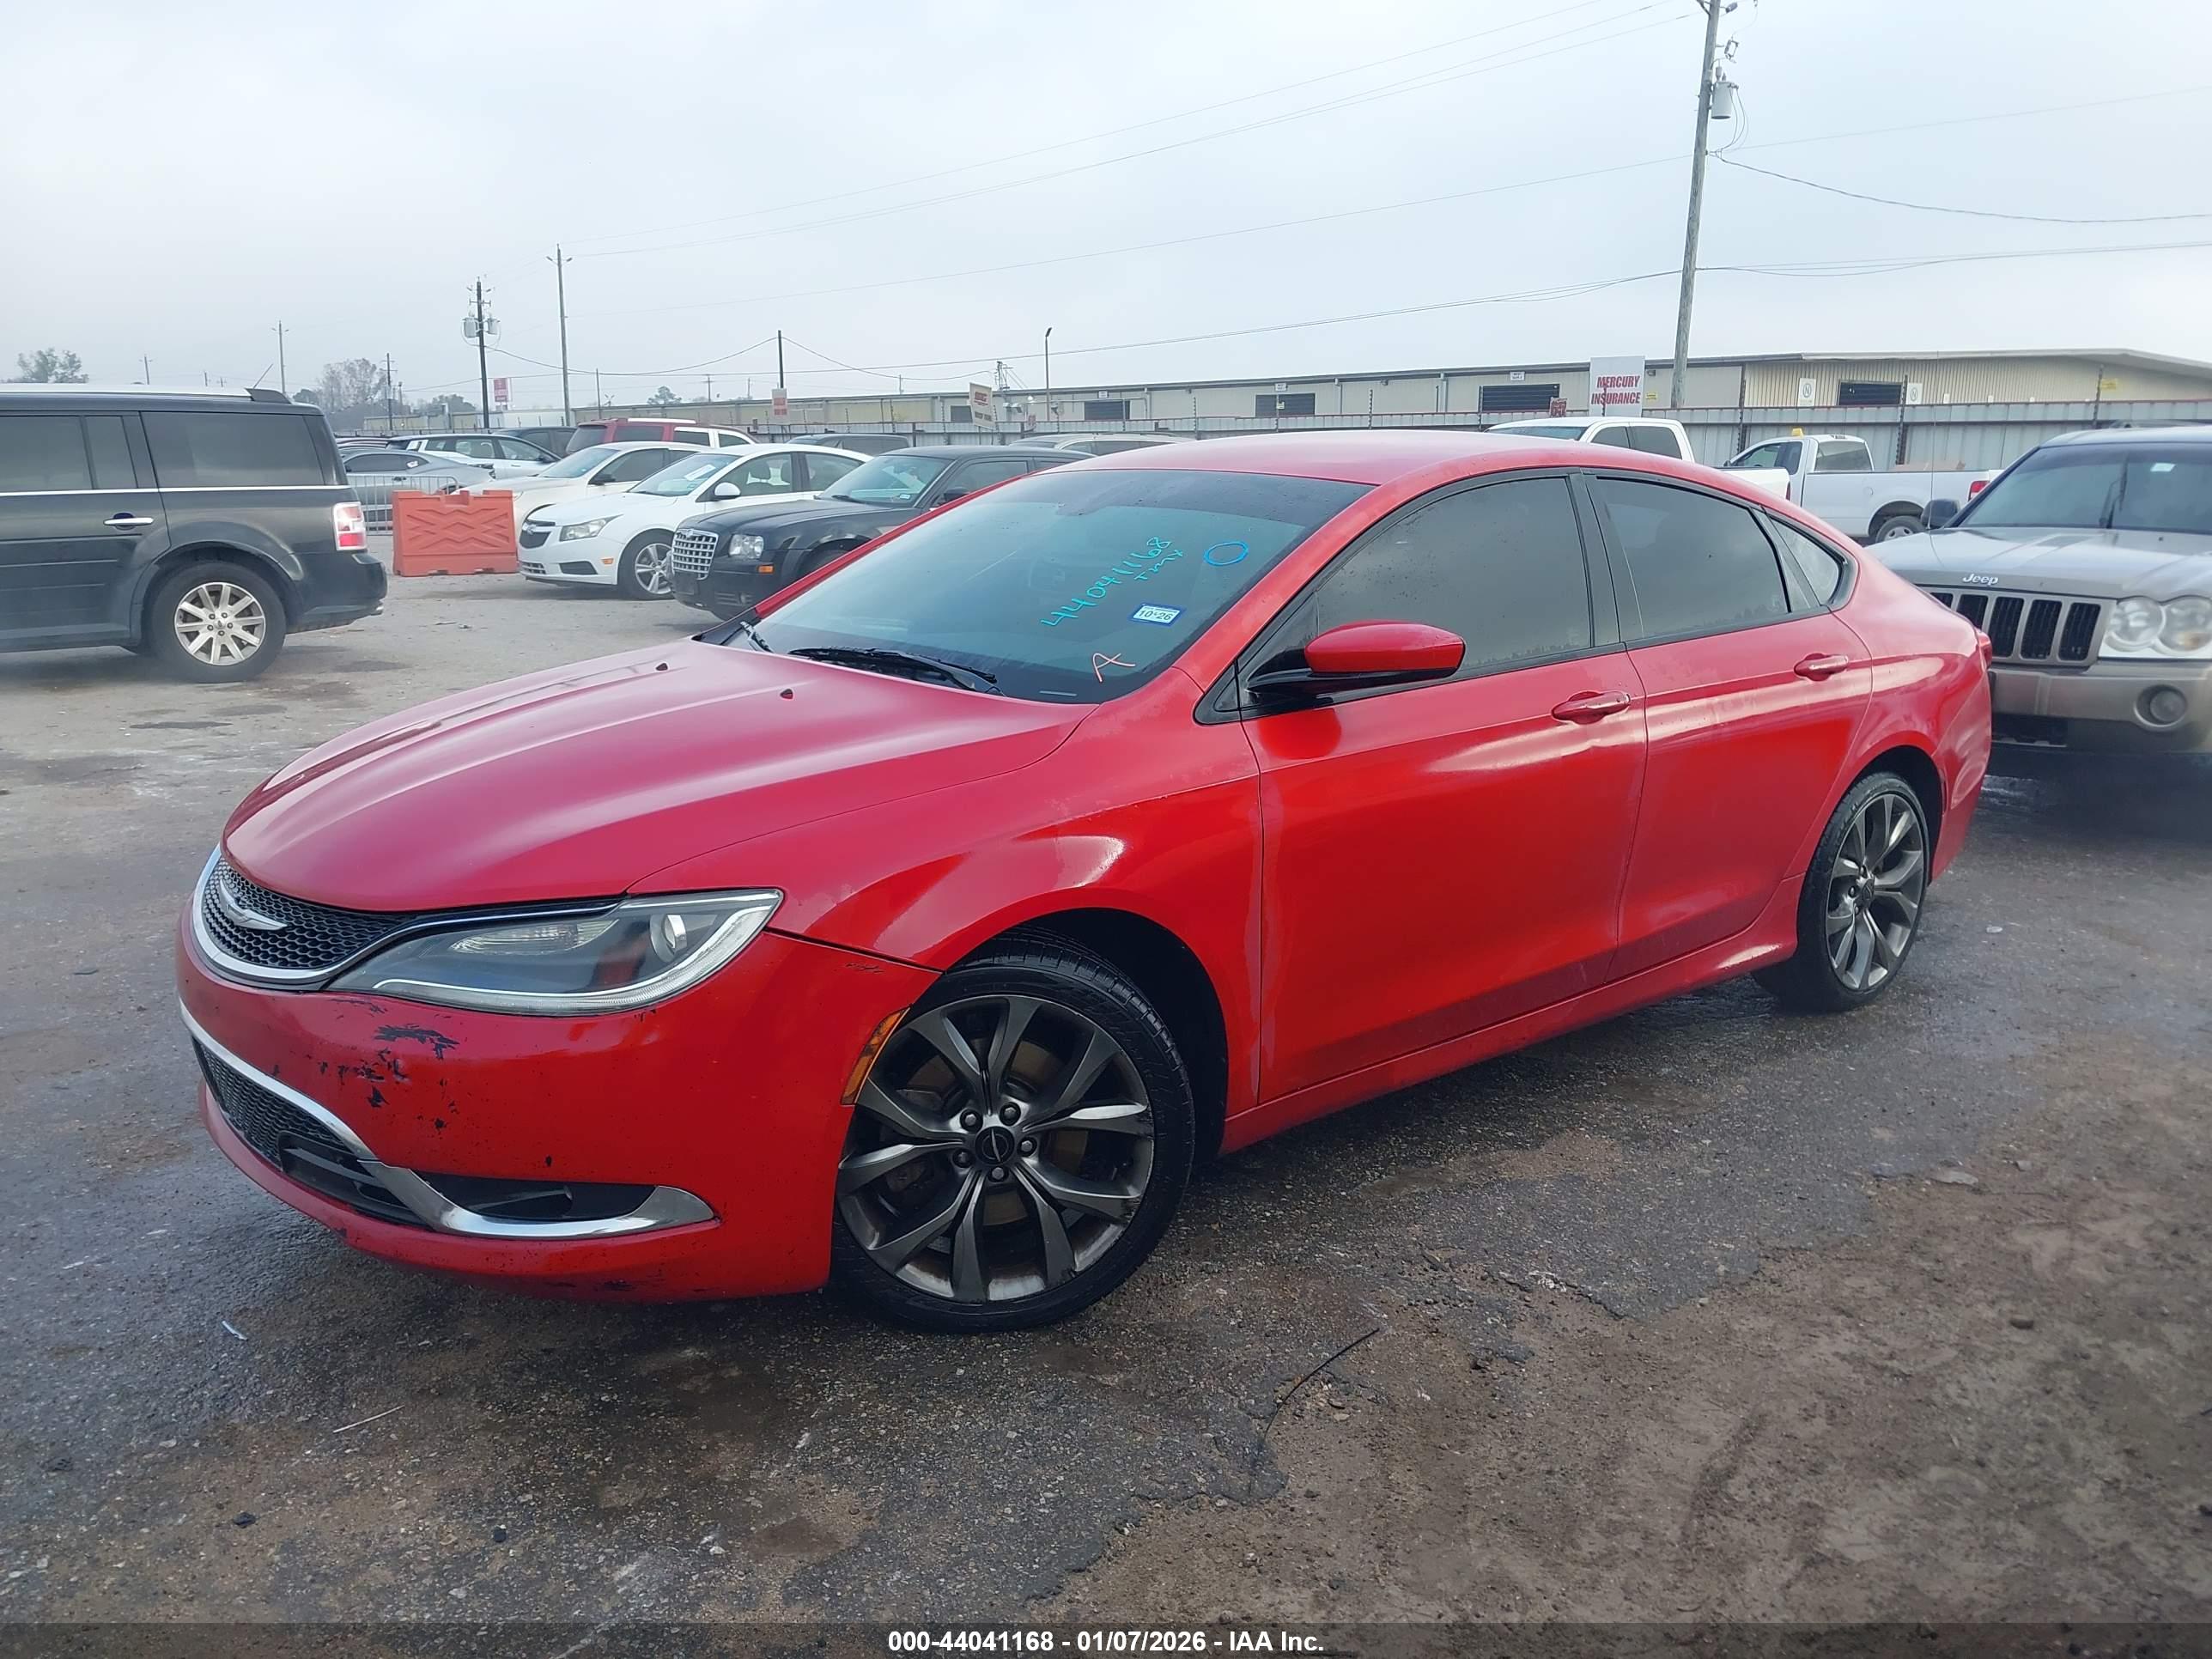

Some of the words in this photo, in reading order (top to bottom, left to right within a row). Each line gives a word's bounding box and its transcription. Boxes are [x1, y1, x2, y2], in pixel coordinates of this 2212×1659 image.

[1596, 375, 1641, 388] MERCURY
[1591, 392, 1641, 405] INSURANCE
[1041, 537, 1172, 625] 44041168
[1962, 574, 1998, 586] Jeep
